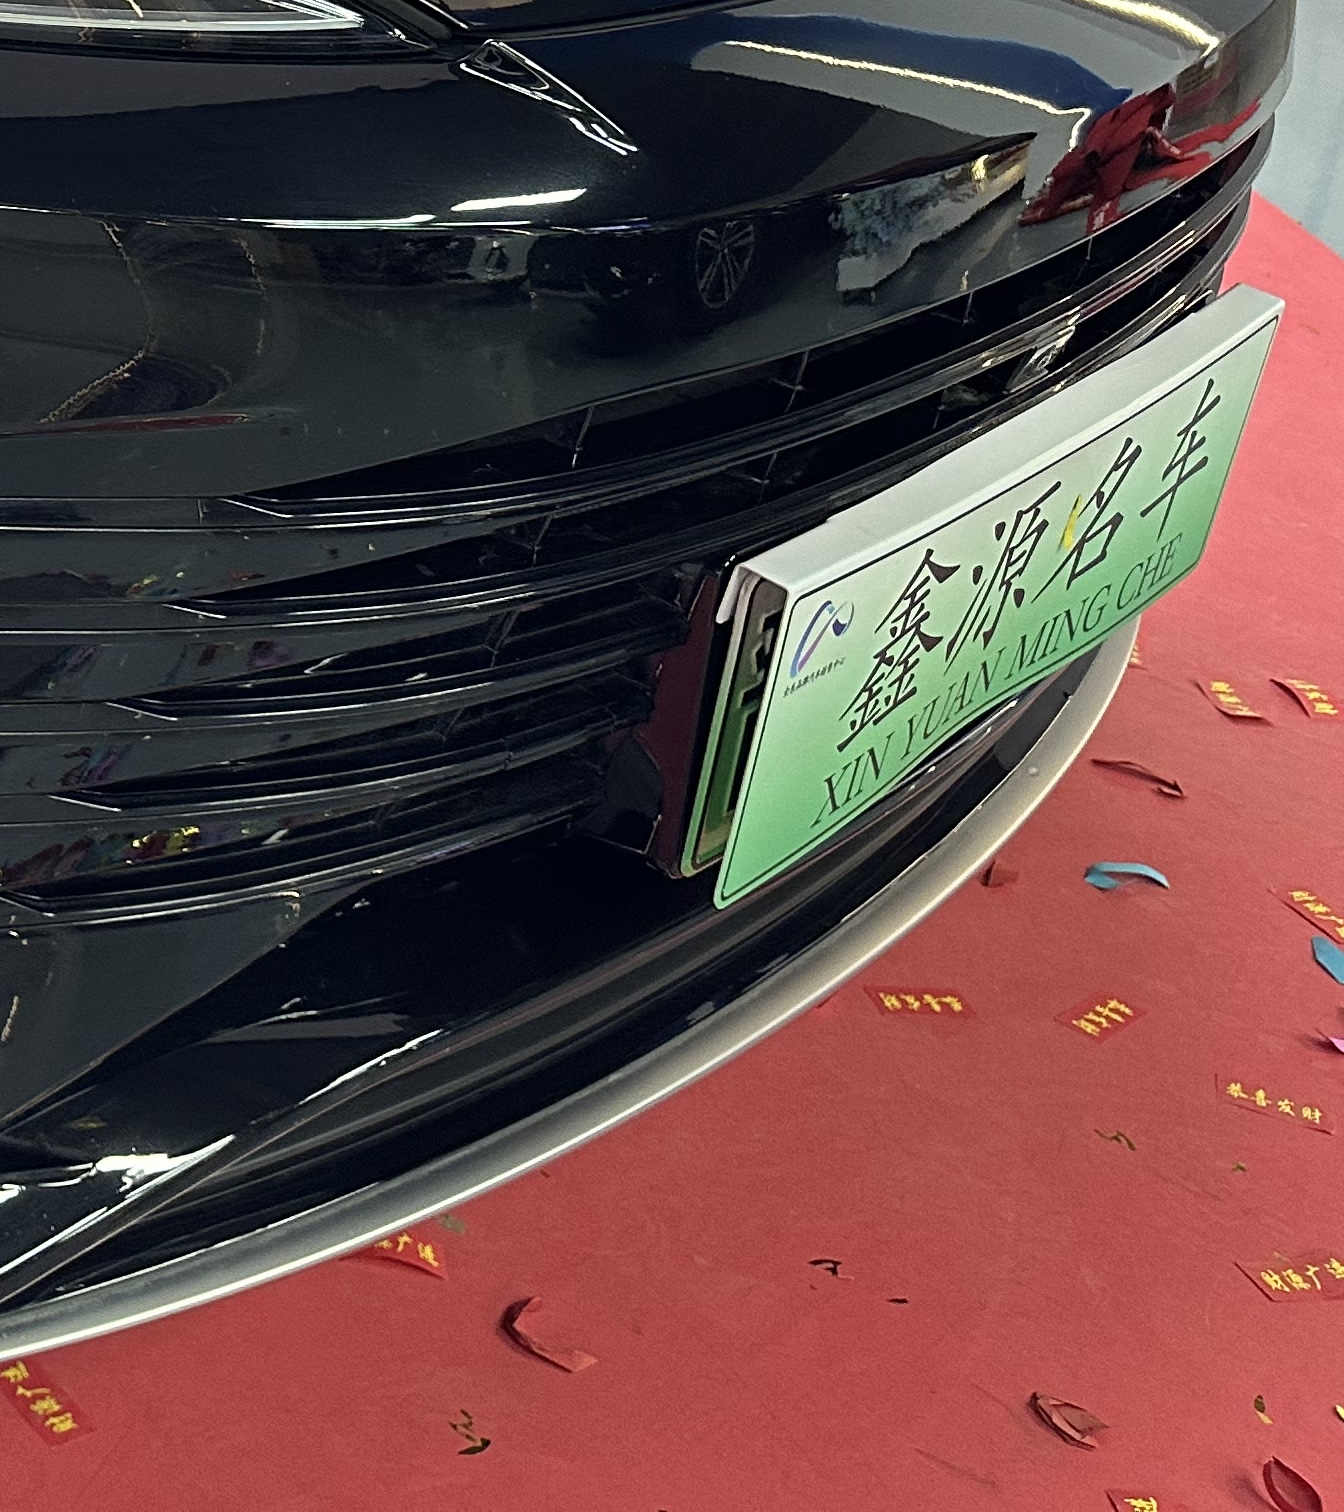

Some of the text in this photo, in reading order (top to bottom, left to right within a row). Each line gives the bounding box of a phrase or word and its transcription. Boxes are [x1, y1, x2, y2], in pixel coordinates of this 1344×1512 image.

[811, 533, 1184, 829] XIN YUAN MING CHE
[836, 378, 1221, 754] 鑫源名车
